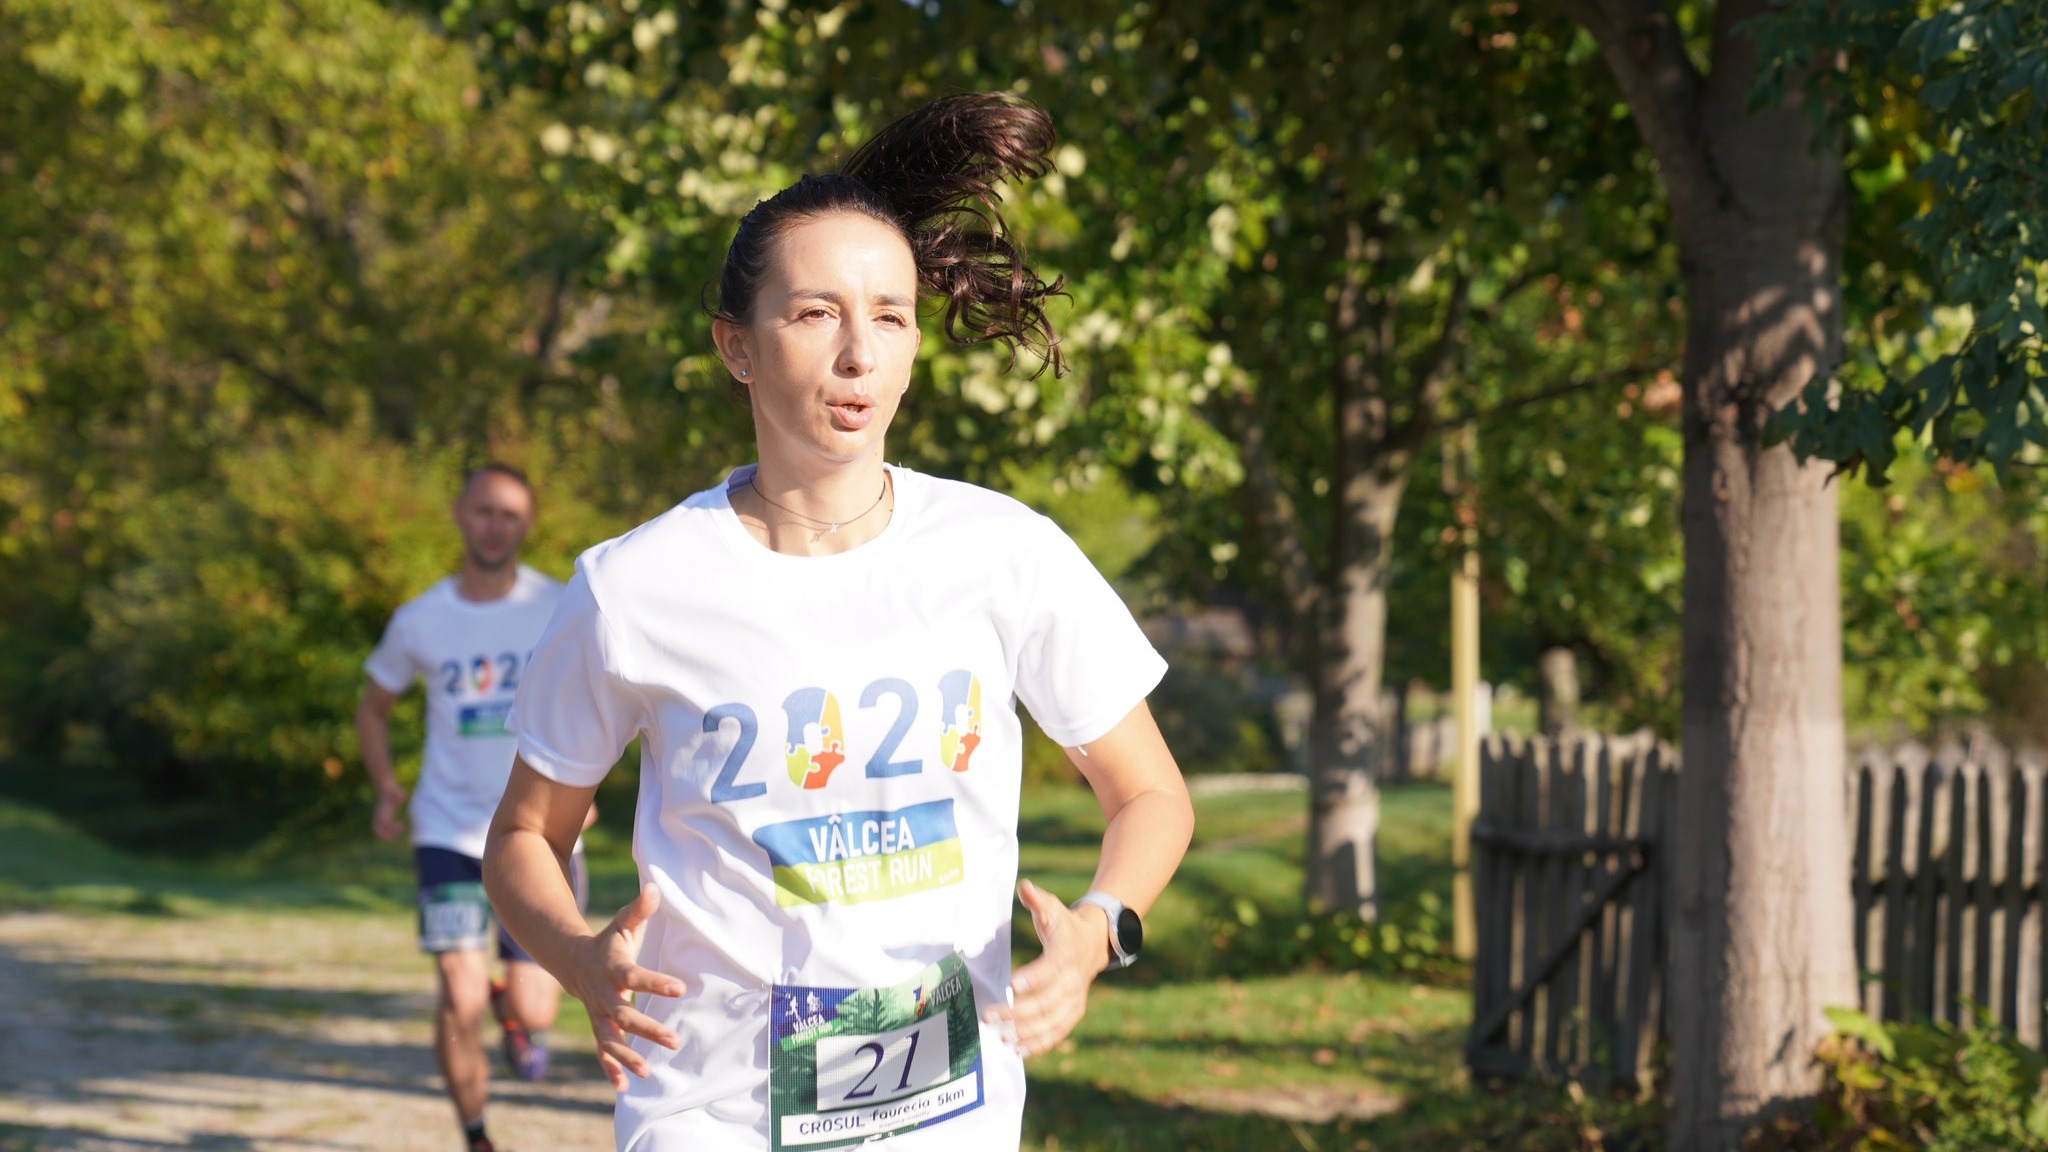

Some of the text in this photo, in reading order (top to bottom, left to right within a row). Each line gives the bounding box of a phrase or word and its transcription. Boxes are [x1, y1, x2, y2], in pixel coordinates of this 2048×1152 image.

[808, 814, 916, 863] VÂLCEA
[889, 851, 932, 888] RUN
[843, 1029, 920, 1101] 21
[799, 1115, 865, 1135] CROSUL
[871, 1099, 930, 1121] faurecia
[937, 1087, 965, 1106] 5km
